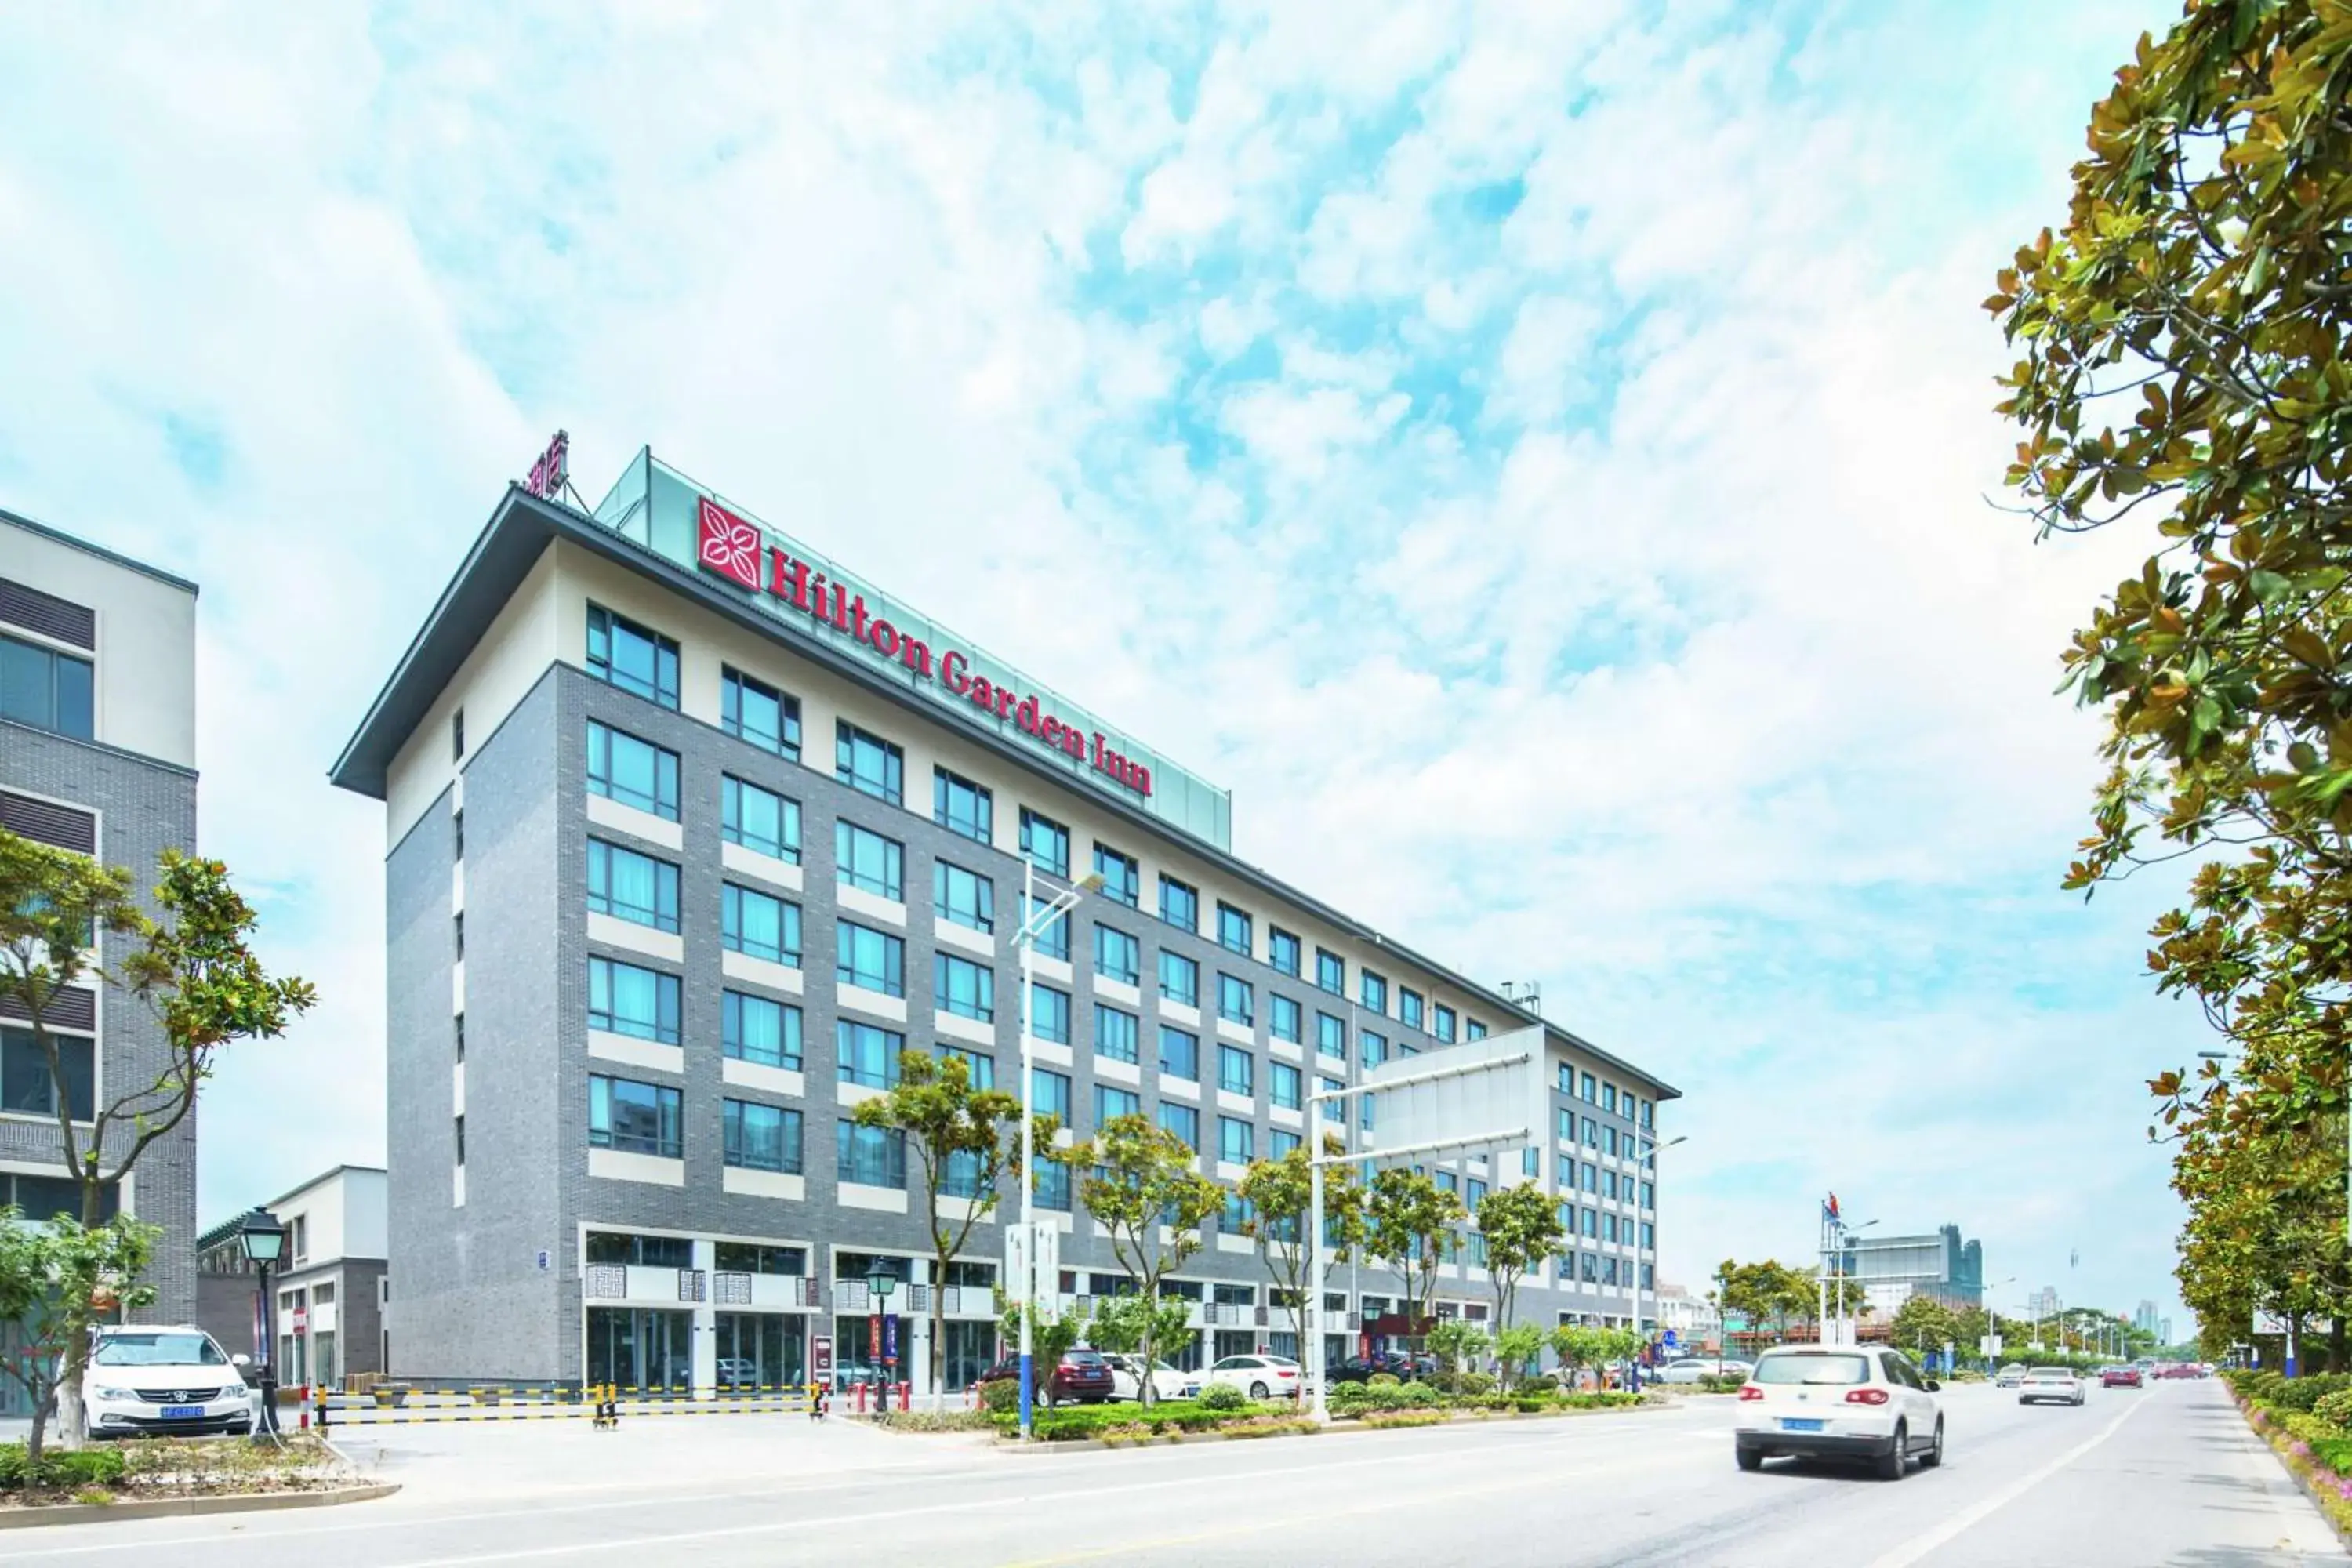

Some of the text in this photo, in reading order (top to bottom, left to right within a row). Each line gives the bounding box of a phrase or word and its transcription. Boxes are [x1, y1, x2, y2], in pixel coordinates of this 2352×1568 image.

[768, 545, 1152, 797] Hilton Garden Inn
